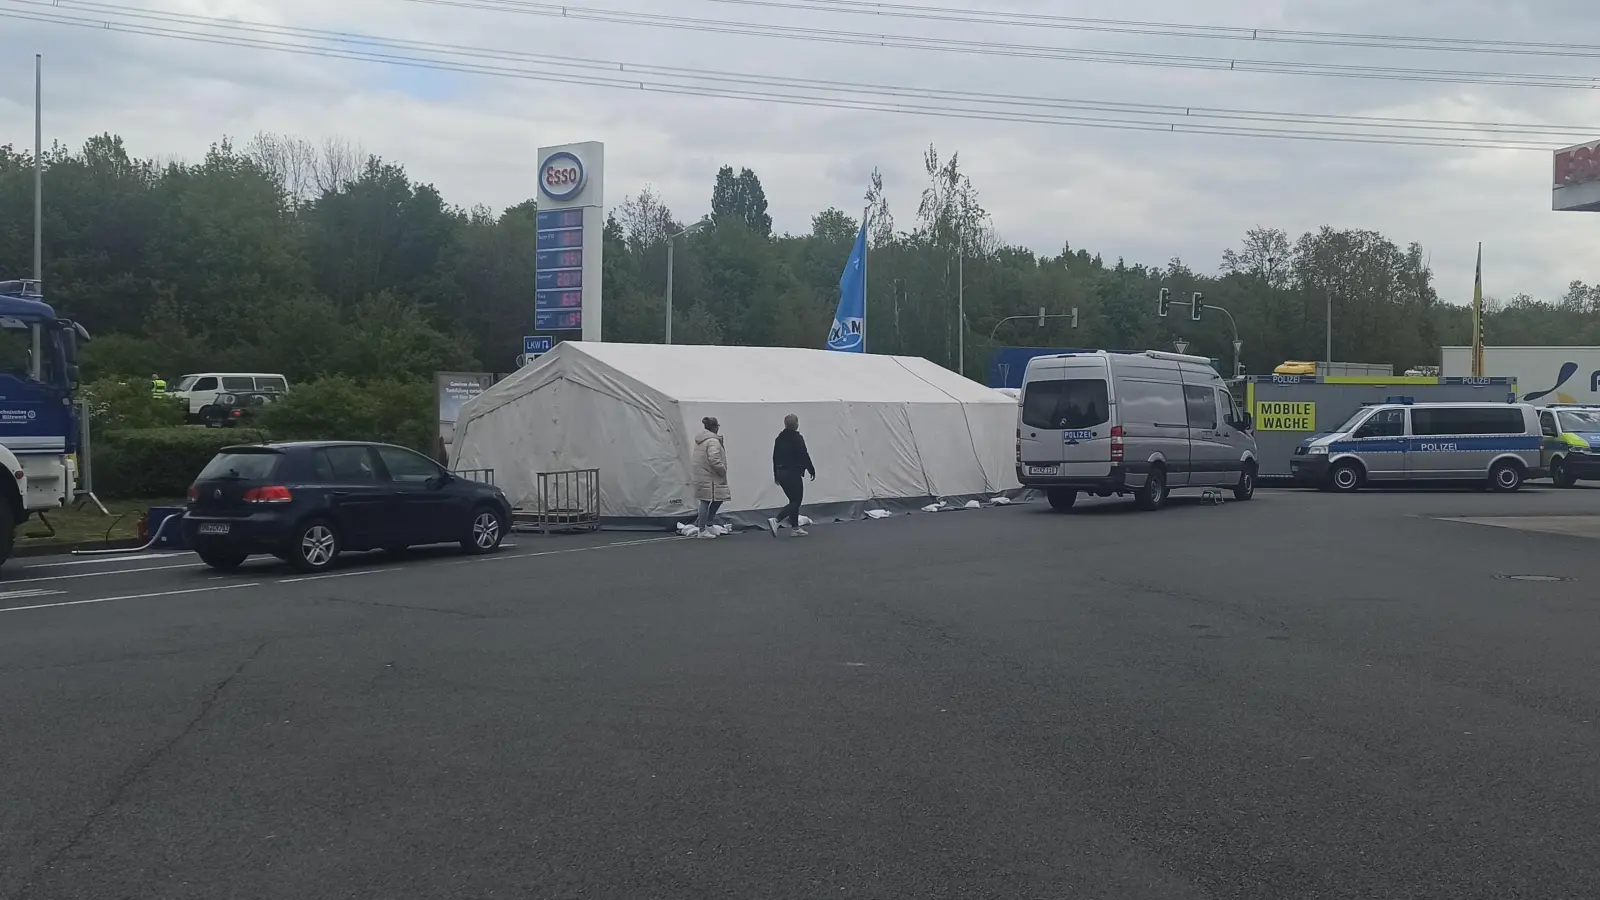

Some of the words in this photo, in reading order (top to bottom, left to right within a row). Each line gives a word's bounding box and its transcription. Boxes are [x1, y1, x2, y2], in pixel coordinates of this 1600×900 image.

[1555, 144, 1600, 184] ES
[526, 340, 541, 350] LKW
[1273, 375, 1300, 383] POLIZEI
[1462, 377, 1491, 385] POLIZEI
[1261, 403, 1311, 415] MOBILE
[1263, 417, 1309, 429] WACHE
[1064, 431, 1091, 439] POLIZEI
[1421, 443, 1458, 451] POLIZEI
